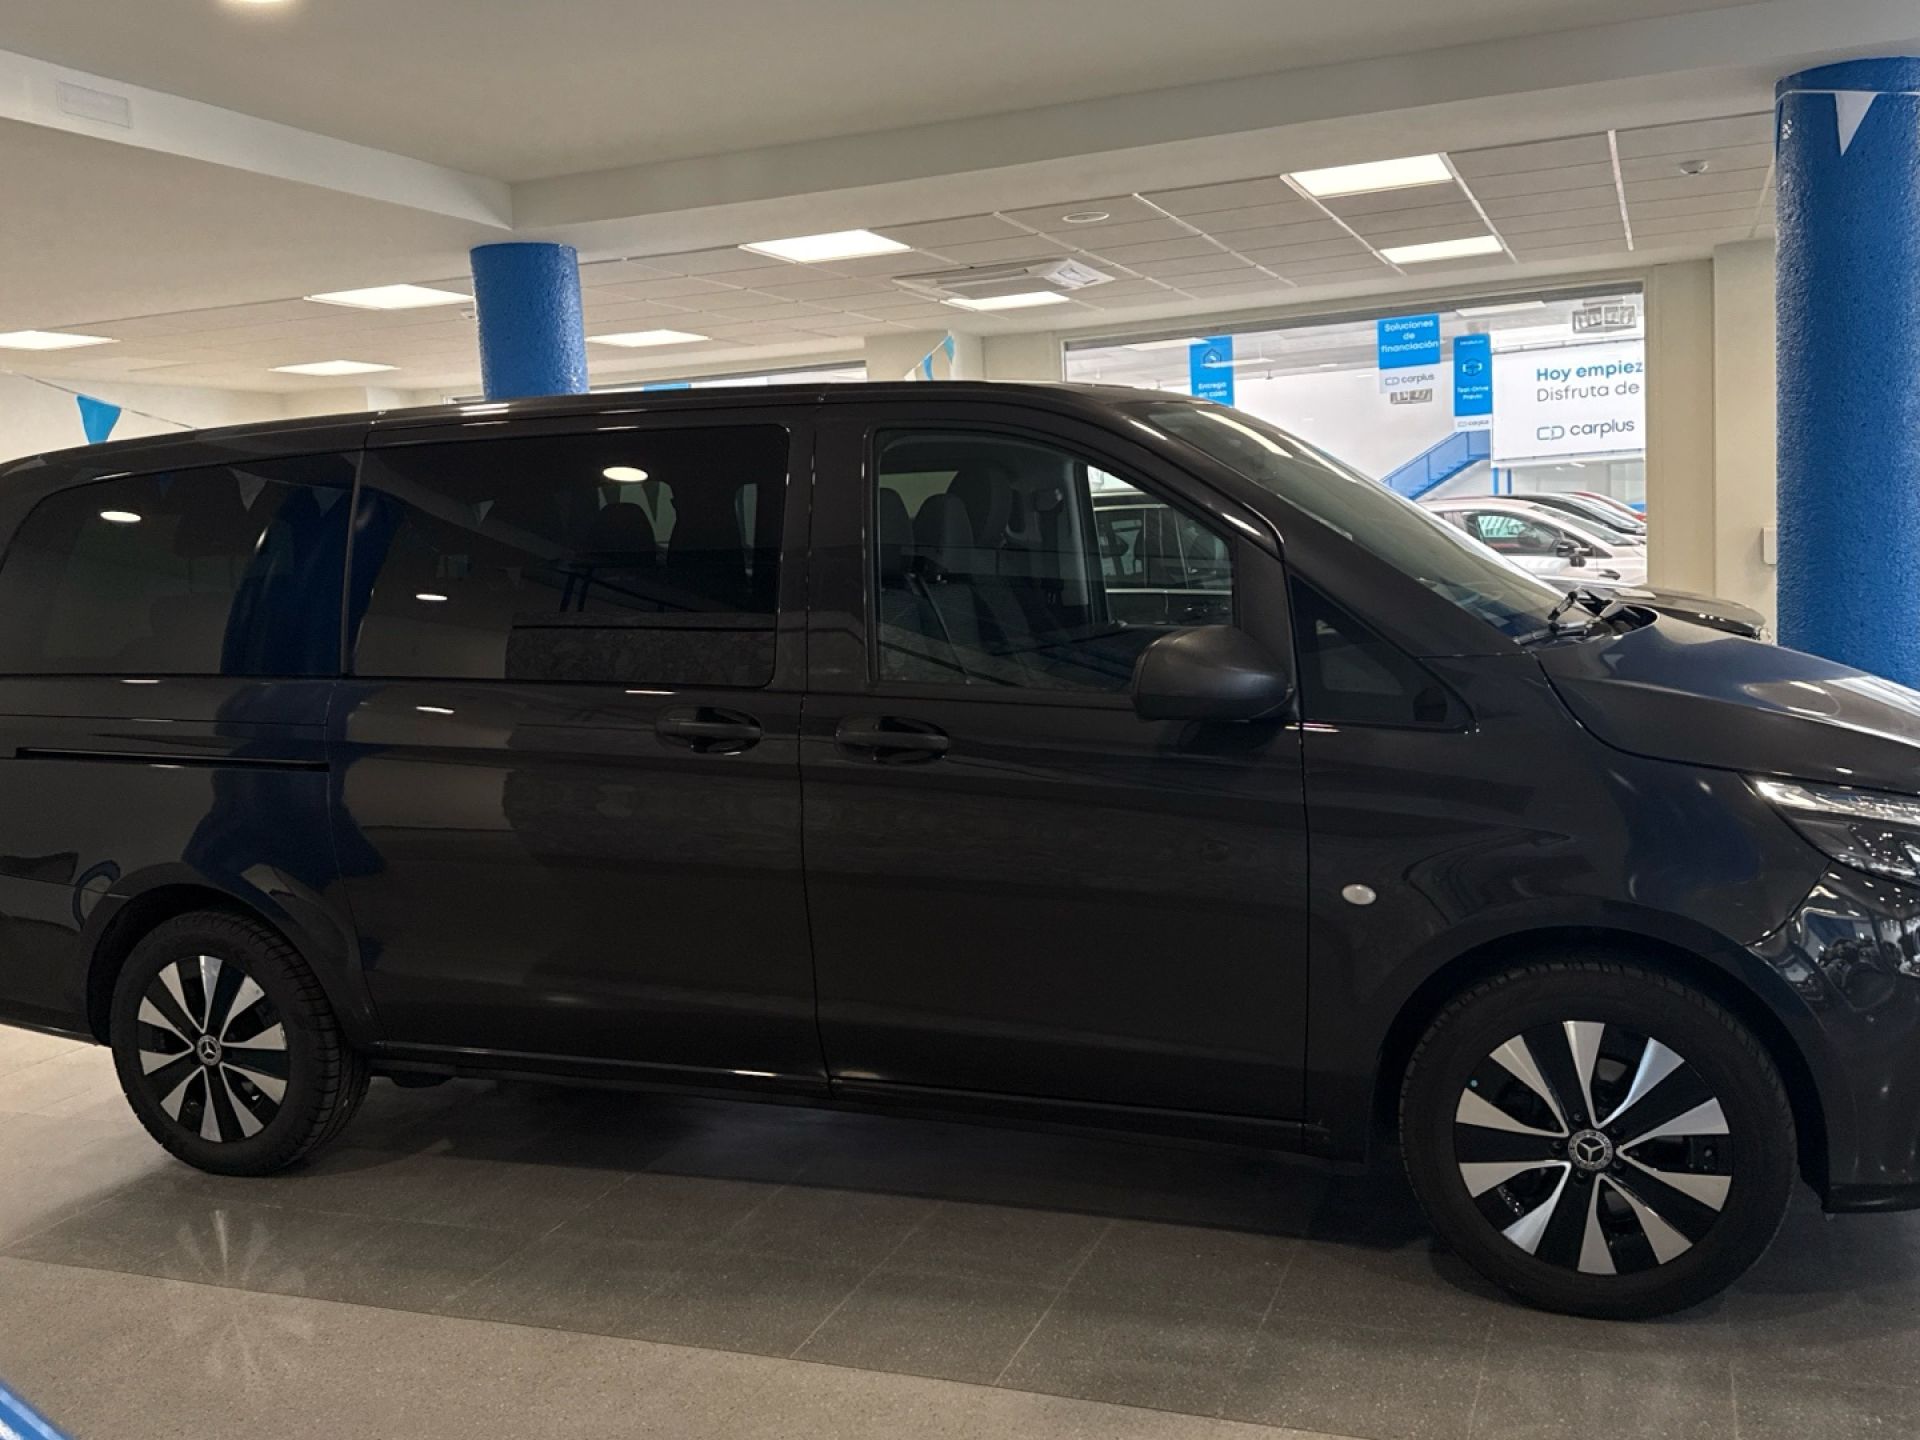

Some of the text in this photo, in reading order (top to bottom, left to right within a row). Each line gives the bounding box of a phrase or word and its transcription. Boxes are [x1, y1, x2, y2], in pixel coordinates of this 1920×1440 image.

[1383, 320, 1434, 333] Soluciones
[1402, 332, 1416, 341] de
[1380, 340, 1439, 353] financiación
[1536, 360, 1644, 383] Hoy empiez
[1400, 373, 1435, 385] carplus
[1536, 381, 1641, 402] Disfruta de
[1570, 418, 1635, 439] carplus
